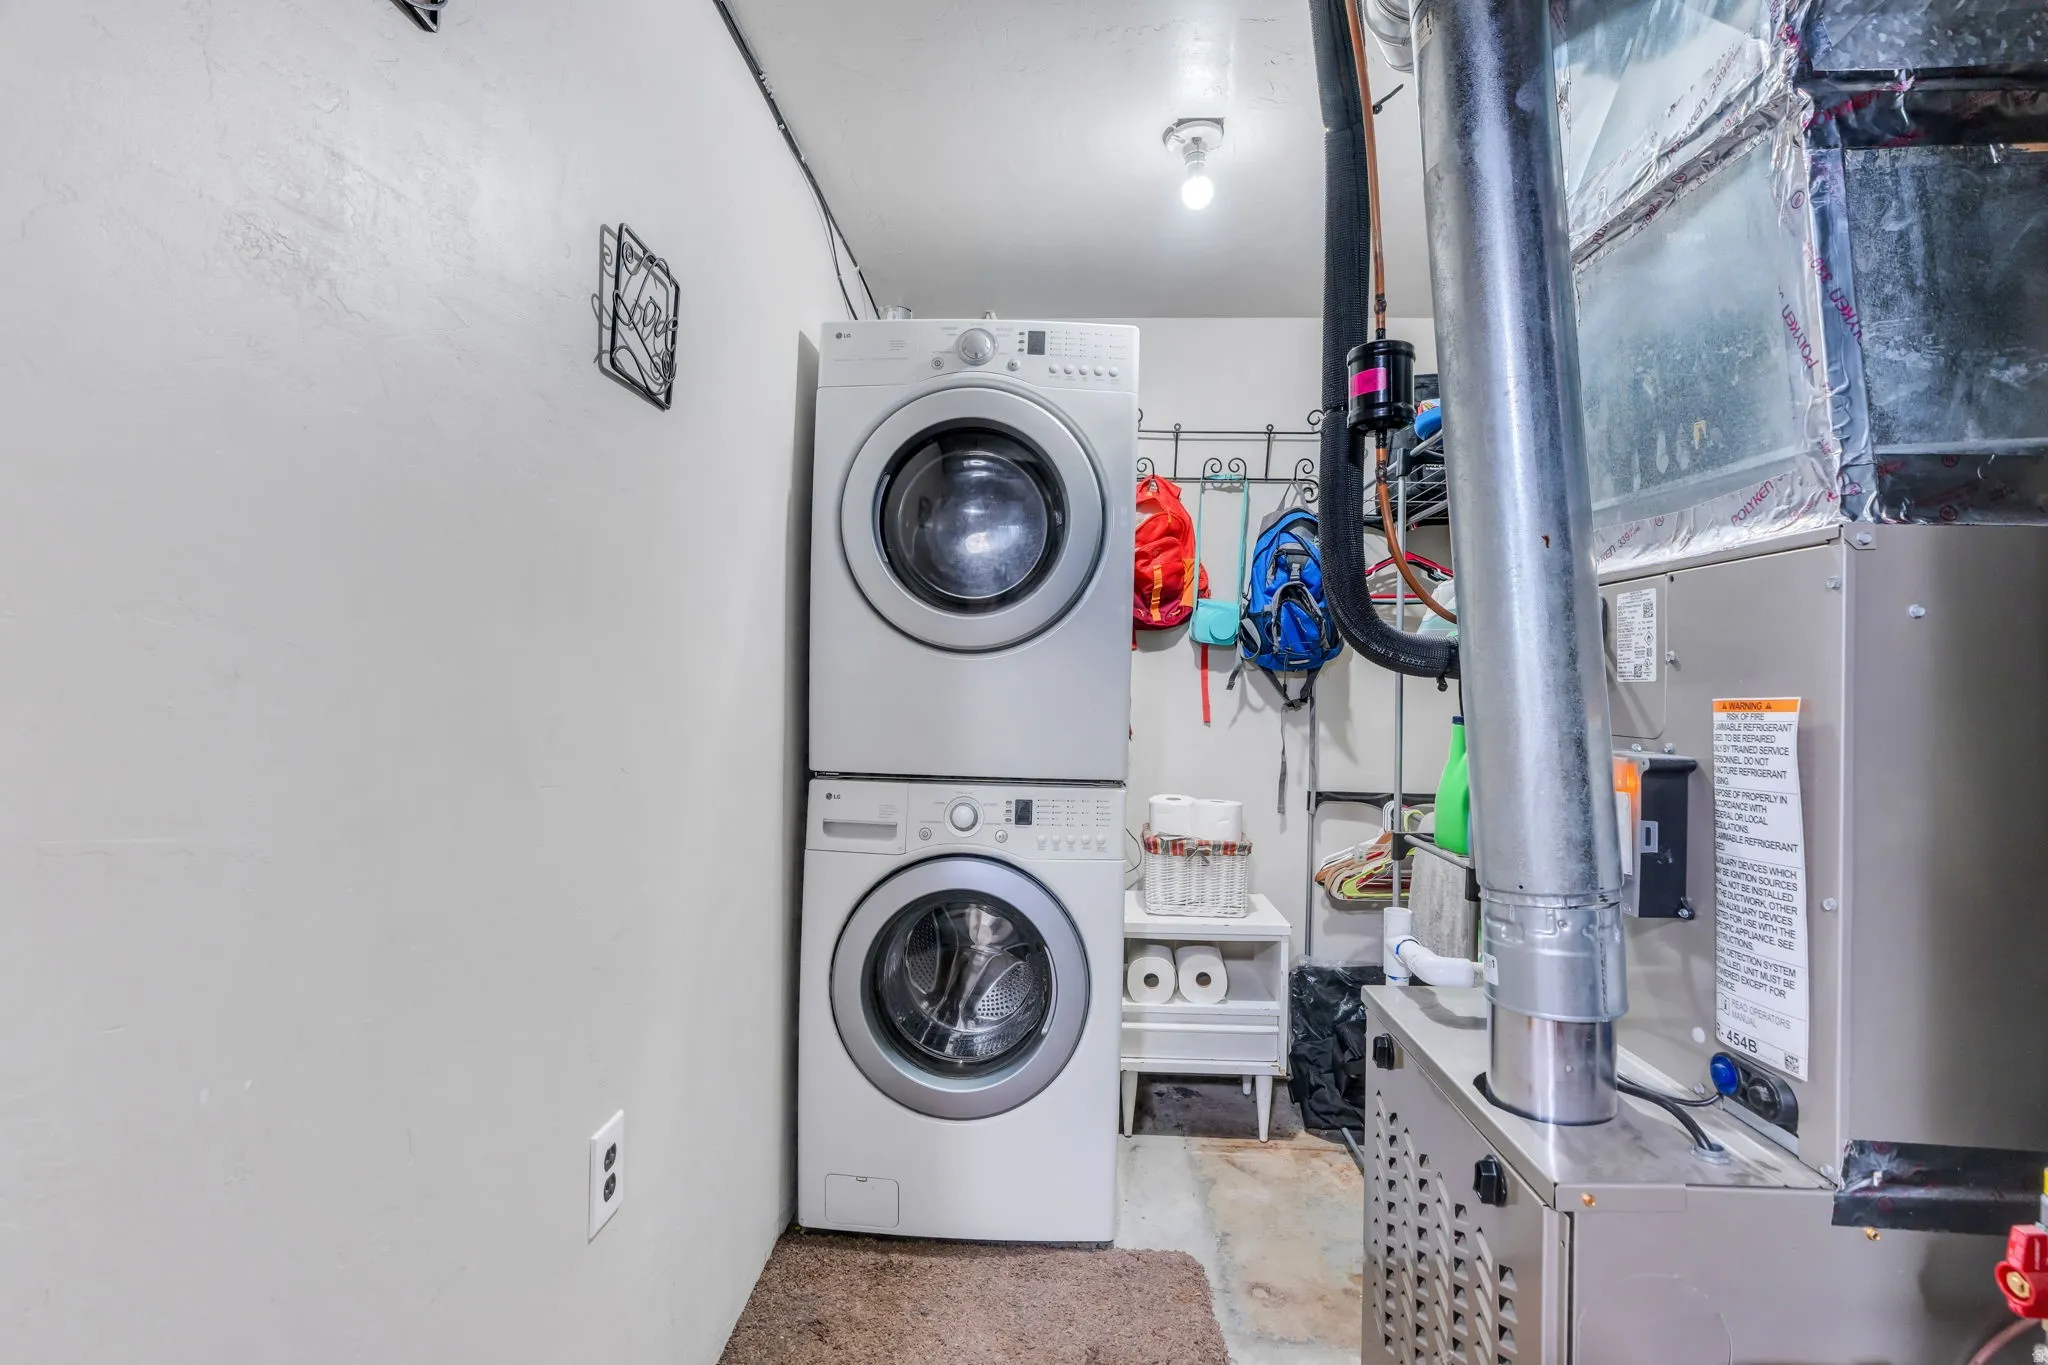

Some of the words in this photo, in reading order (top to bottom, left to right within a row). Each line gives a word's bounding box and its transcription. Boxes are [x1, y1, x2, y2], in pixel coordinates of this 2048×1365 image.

[1781, 303, 1820, 369] POLYKEN
[1731, 480, 1774, 526] POLYKEN
[1733, 734, 1741, 742] BE
[1742, 735, 1775, 743] REPAIRED
[1731, 745, 1757, 754] TRAINED
[1760, 746, 1788, 755] SERVICE
[1755, 758, 1768, 766] NOT
[1739, 767, 1787, 779] REFRIGERANT
[1733, 790, 1741, 798] OF
[1742, 791, 1778, 802] PROPERLY
[1780, 795, 1787, 804] IN
[1750, 805, 1767, 813] WITH
[1735, 813, 1744, 821] OR
[1745, 814, 1768, 825] LOCAL
[1745, 837, 1798, 853] REFRIGERANT
[1738, 860, 1768, 874] DEVICES
[1770, 866, 1797, 879] WHICH
[1723, 868, 1730, 876] BE
[1731, 870, 1757, 883] IGNITION
[1759, 876, 1797, 891] SOURCES
[1728, 881, 1740, 889] NOT
[1742, 884, 1750, 893] BE
[1752, 887, 1794, 902] INSTALLED
[1770, 902, 1797, 915] OTHER
[1730, 914, 1742, 924] FOR
[1744, 918, 1756, 929] USE
[1758, 924, 1777, 934] WITH
[1780, 928, 1796, 939] THE
[1759, 911, 1793, 926] DEVICES
[1778, 938, 1794, 950] SEE
[1727, 949, 1762, 966] DETECTION
[1763, 962, 1796, 977] SYSTEM
[1744, 966, 1758, 977] UNIT
[1761, 971, 1780, 983] MUST
[1783, 978, 1795, 989] BE
[1741, 975, 1767, 992] EXCEPT
[1770, 986, 1786, 999] FOR
[1732, 1000, 1748, 1012] READ
[1749, 1007, 1790, 1029] OPERATORS
[1732, 1011, 1757, 1028] MANUAL
